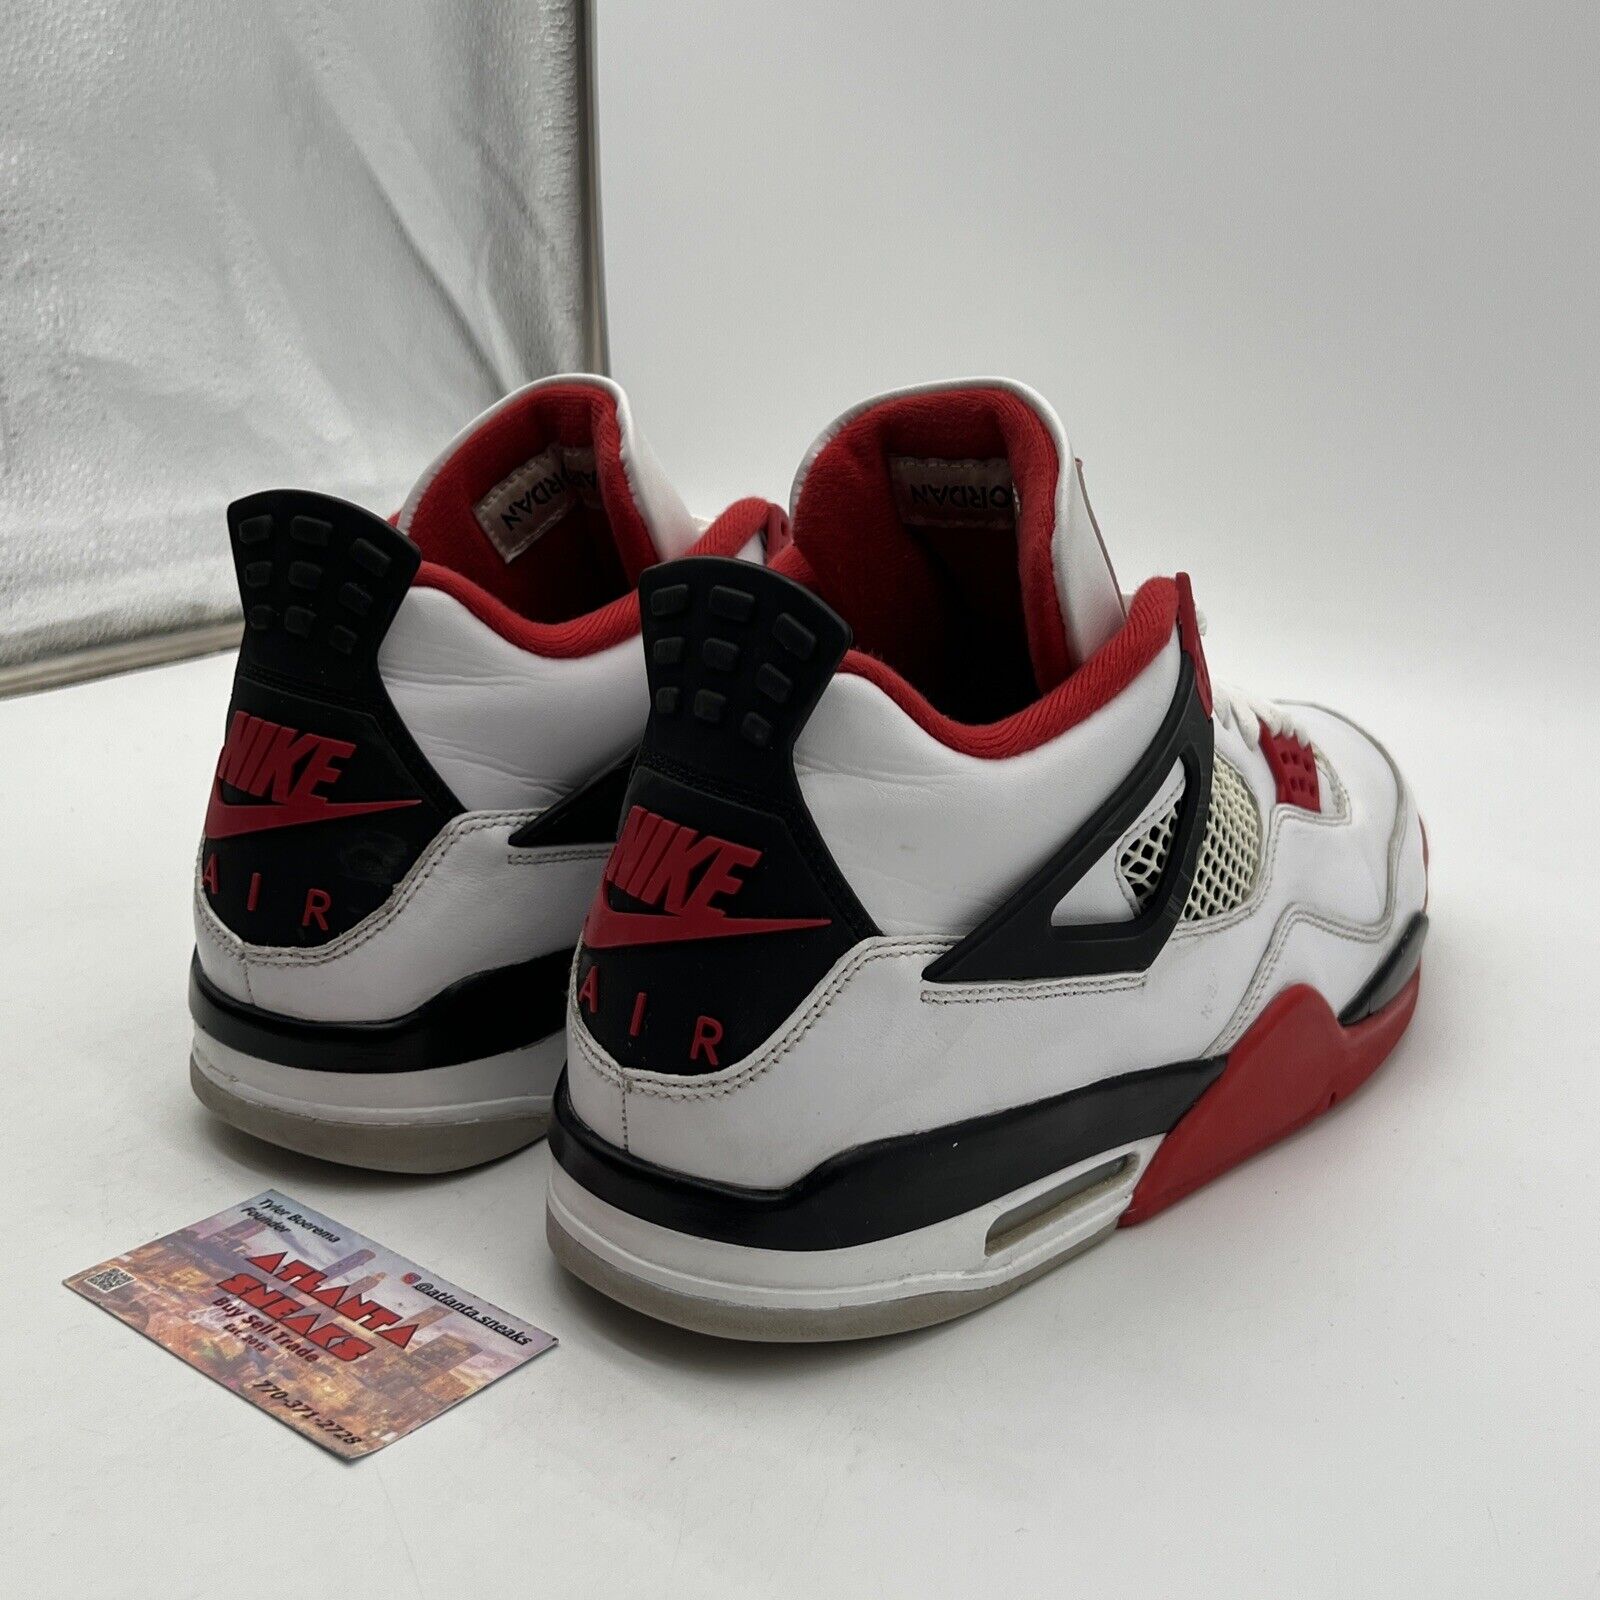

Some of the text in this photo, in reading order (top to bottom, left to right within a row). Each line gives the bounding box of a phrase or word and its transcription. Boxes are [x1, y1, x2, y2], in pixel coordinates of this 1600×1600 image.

[910, 483, 1012, 508] ORDAN
[217, 710, 357, 804] NIKE
[202, 852, 332, 931] AIR
[605, 804, 762, 918] NIKE
[578, 965, 724, 1066] AIR
[240, 1206, 291, 1233] Founder
[259, 1198, 341, 1243] Tyler Boerema
[213, 1297, 320, 1363] Buy Sell Trade
[216, 1272, 376, 1362] SNEAKS
[245, 1251, 419, 1349] ATLANTA
[412, 1282, 533, 1346] @atlanta.sneaks
[241, 1335, 268, 1352] 2015
[253, 1380, 362, 1444] 770-371-2728
